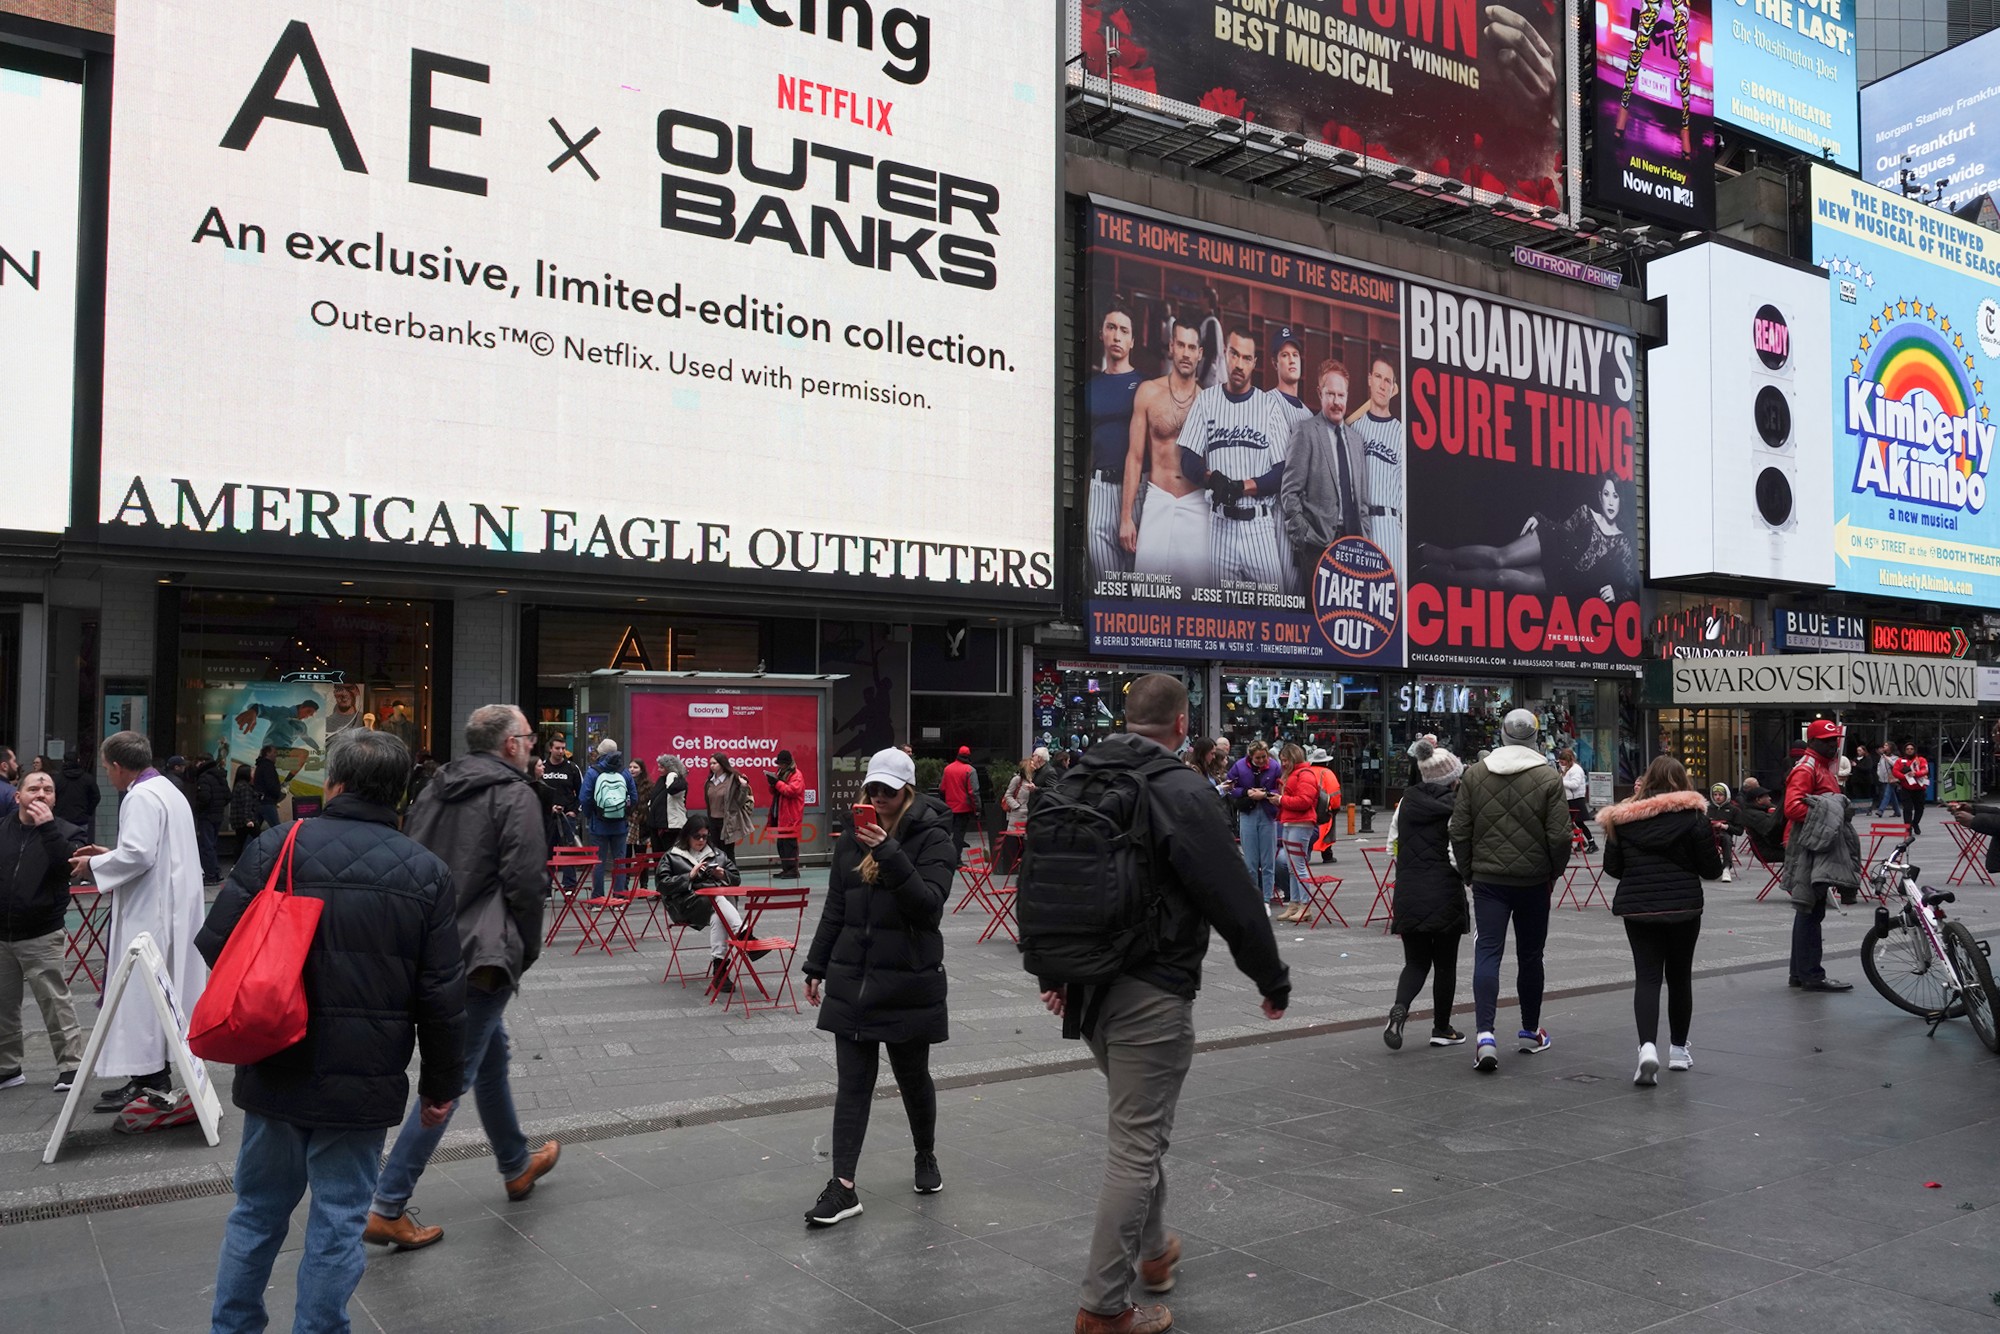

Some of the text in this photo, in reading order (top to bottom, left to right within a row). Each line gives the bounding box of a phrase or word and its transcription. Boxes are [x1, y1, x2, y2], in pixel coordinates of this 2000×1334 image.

[1285, 2, 1320, 34] AND
[1215, 6, 1279, 56] BEST
[1286, 30, 1393, 95] MUSICAL
[1732, 19, 1837, 81] The Washington Post
[778, 73, 893, 136] NETFLIX
[1752, 81, 1832, 129] BOOTH THEATRE
[1876, 122, 1912, 143] Morgan
[1915, 105, 1954, 126] Stanley
[1908, 122, 1976, 157] Frankfurt
[657, 109, 1000, 236] OUTER
[1623, 170, 1652, 195] Now
[1655, 186, 1671, 201] on
[1630, 156, 1686, 185] All New Friday
[1948, 163, 1984, 185] wide
[661, 173, 997, 290] BANKS
[1818, 198, 1850, 224] NEW
[1855, 211, 1915, 248] MUSICAL
[1919, 236, 1934, 254] OF
[1938, 242, 1961, 264] THE
[1851, 189, 1877, 214] THE
[1882, 201, 1983, 252] BEST-REVIEWED
[1097, 213, 1394, 304] THE HOME-RUN HIT OF THE SEASON!
[192, 206, 1015, 372] An exclusive, limited-edition collection.
[1412, 283, 1634, 402] BROADWAY'S
[1755, 318, 1788, 356] READY
[564, 336, 660, 370] Netflix.
[669, 351, 732, 382] Used
[741, 365, 792, 390] with
[801, 377, 931, 410] permission.
[1207, 419, 1269, 448] Empires
[1411, 367, 1634, 482] SURE THING
[1845, 375, 1997, 478] Kimberly
[1363, 440, 1398, 464] pires
[1852, 437, 1986, 514] Akimbo
[108, 475, 1053, 589] AMERICAN EAGLE OUTFITTERS
[1889, 508, 1957, 530] a new musical
[1335, 550, 1384, 570] BEST REVIVAL
[1356, 541, 1364, 549] THE
[1851, 535, 1861, 547] ON
[1882, 539, 1906, 554] STREET
[1909, 546, 1915, 555] at
[1917, 547, 1927, 557] the
[1936, 547, 1966, 563] BOOTH
[1094, 582, 1181, 600] JESSE WILLIAMS
[1104, 570, 1172, 584] TONY AWARD NOMINEE
[1220, 579, 1278, 592] TONY AWARD WINNER
[1879, 568, 1973, 596] KimberlyAkimbo.com
[1191, 588, 1306, 609] JESSE TYLER FERGUSON
[1319, 566, 1395, 621] TAKE ME
[1093, 612, 1311, 643] THROUGH FEBRUARY 5 ONLY
[1333, 618, 1375, 650] OUT
[1407, 582, 1642, 658] CHICAGO
[1787, 611, 1864, 638] BLUE FIN
[1102, 636, 1323, 656] GERALD SCHOENFELD THEATRE, 236 W. 45TH ST. TAKEMEOUTBWAY.COM
[1548, 633, 1595, 643] THE MUSICAL
[1839, 641, 1864, 650] SUSHI
[1874, 625, 1898, 650] DOS
[1411, 653, 1506, 666] CHICAGOTHEMUSICAL.COM
[1518, 659, 1553, 668] AMBASSADOR
[1555, 660, 1575, 669] THEATRE
[1592, 662, 1609, 670] STREET
[1616, 663, 1642, 671] BROADWAY
[1247, 679, 1345, 710] GRAND
[1676, 665, 1845, 693] SWAROVSKI
[1852, 660, 1976, 699] SWAROVSKI
[1400, 684, 1469, 713] SLAM
[1042, 715, 1053, 726] 26
[672, 736, 778, 752] Get Broadway
[543, 772, 568, 780] adidas
